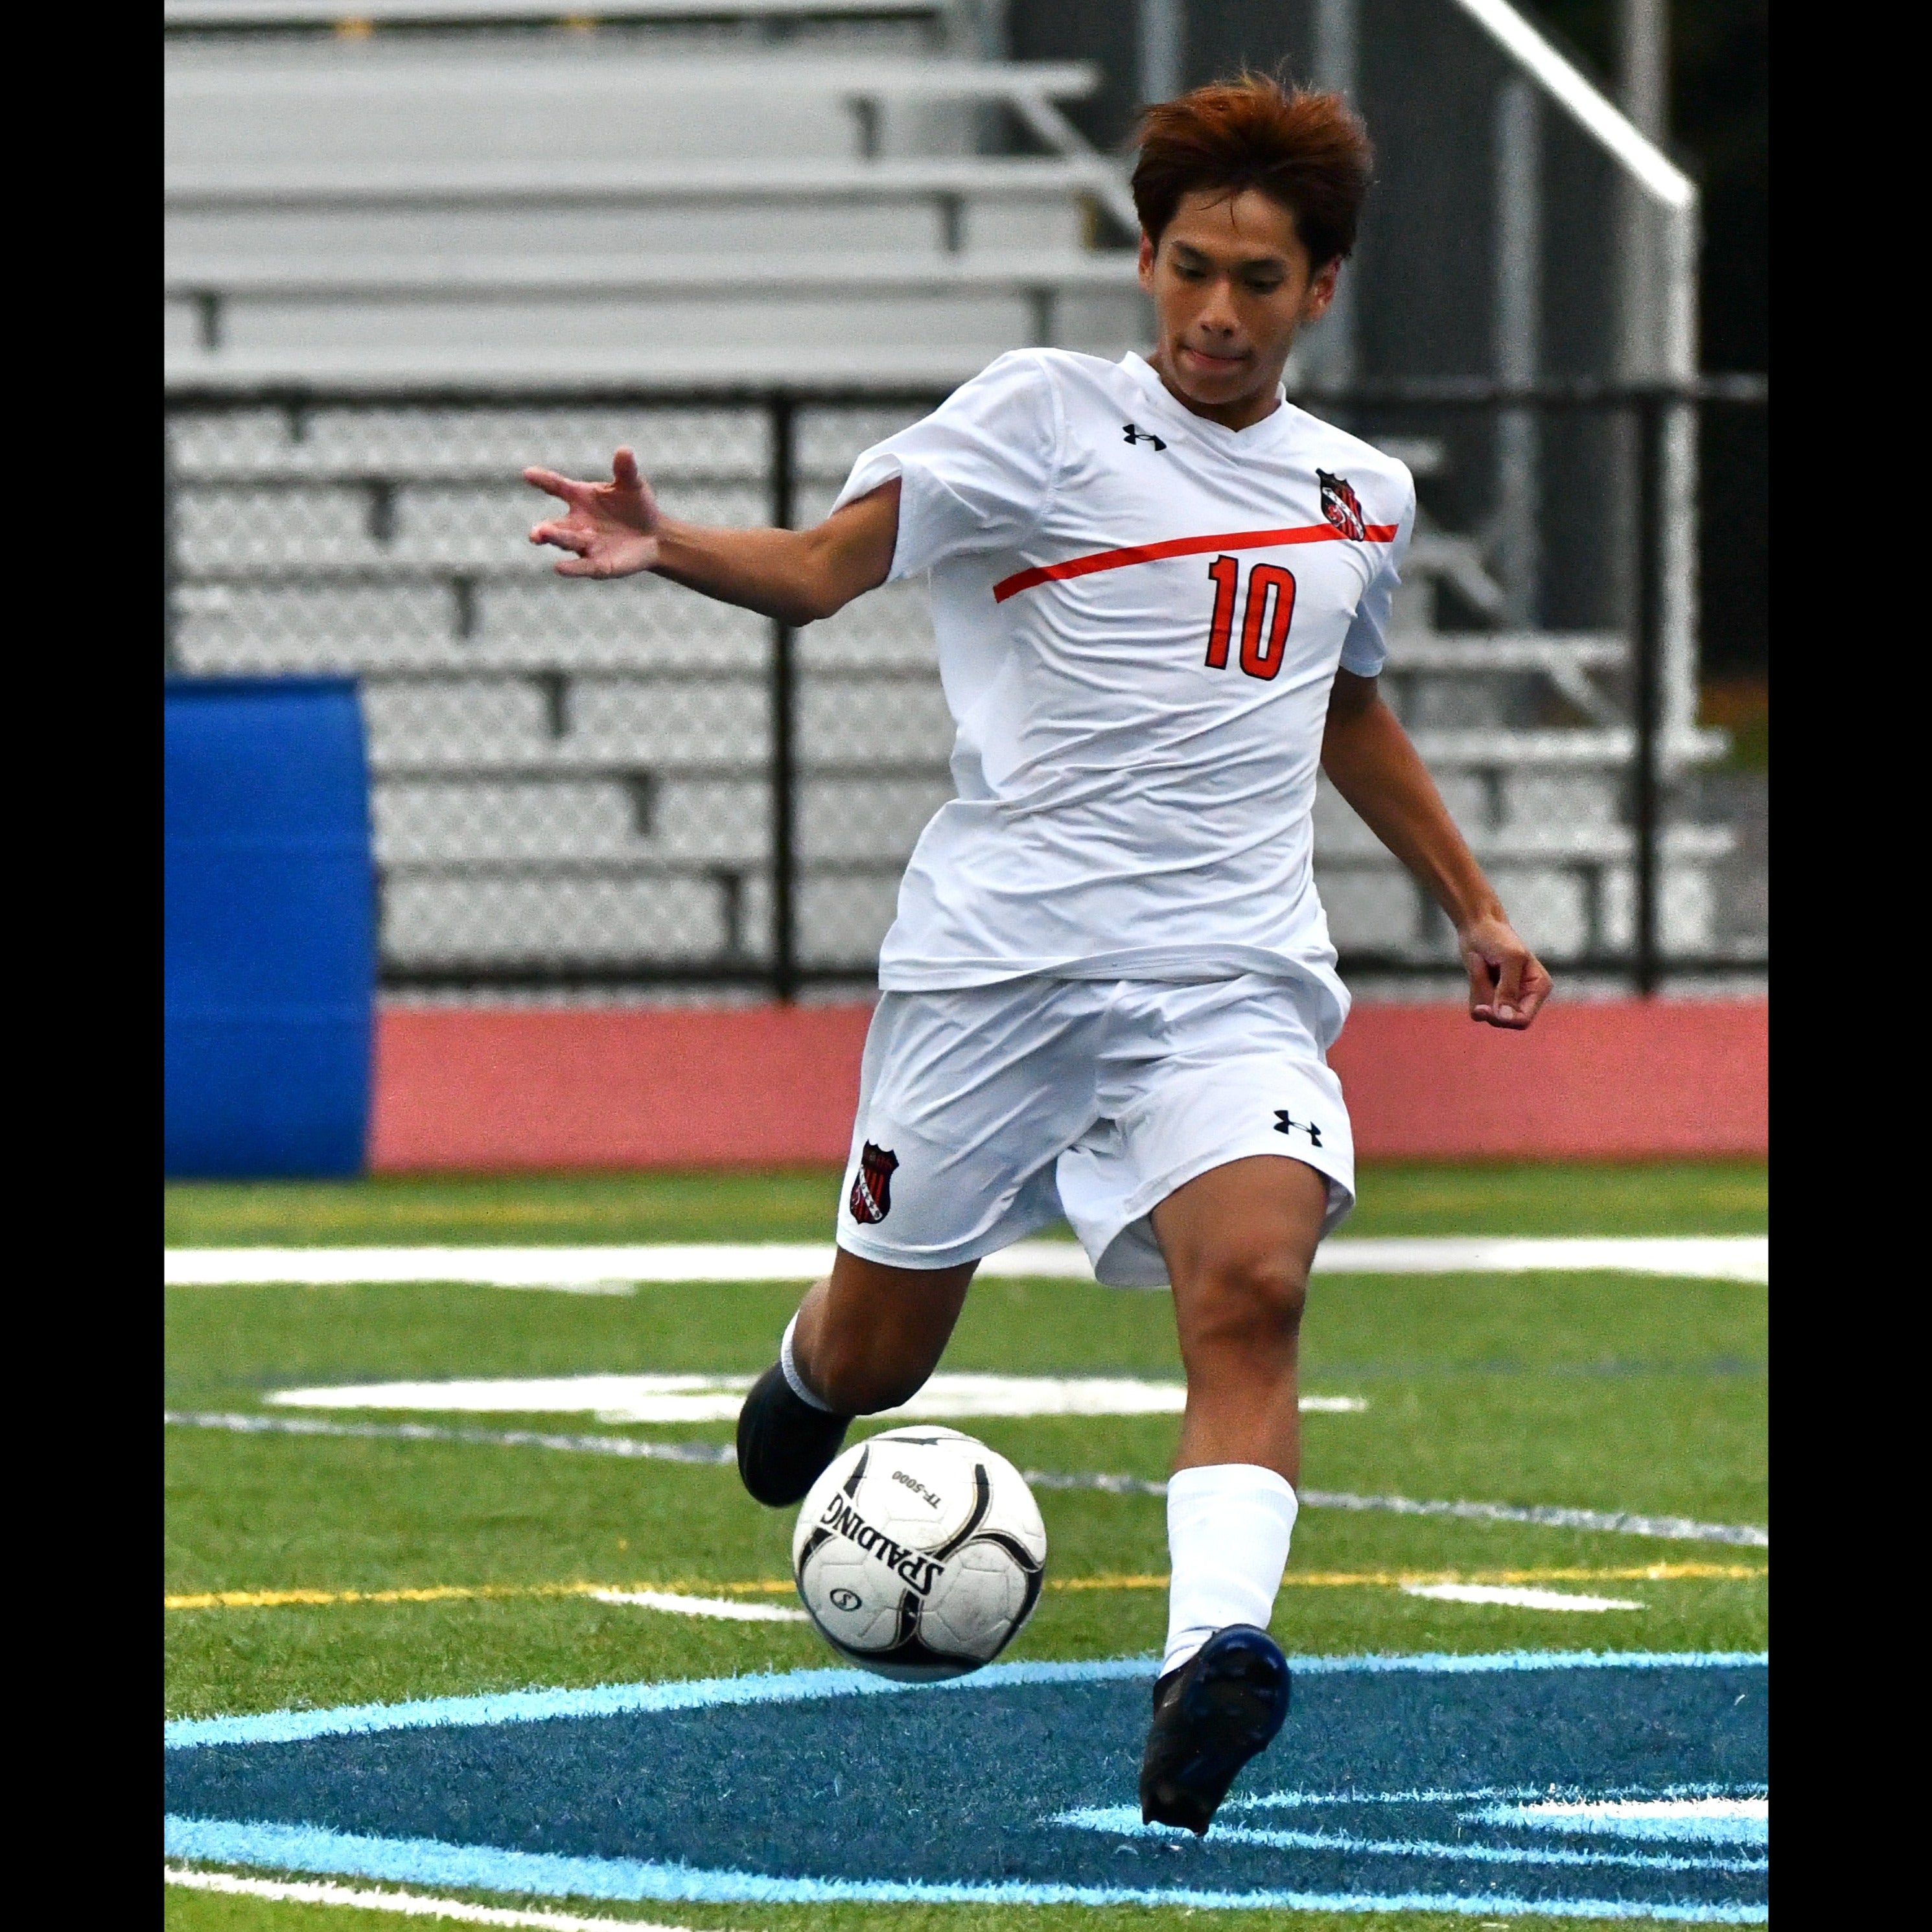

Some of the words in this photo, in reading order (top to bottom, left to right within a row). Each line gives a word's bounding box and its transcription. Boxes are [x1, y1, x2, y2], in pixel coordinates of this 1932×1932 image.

[1204, 554, 1296, 681] 10
[892, 1471, 942, 1509] TF-5000
[821, 1493, 944, 1595] SPALDING
